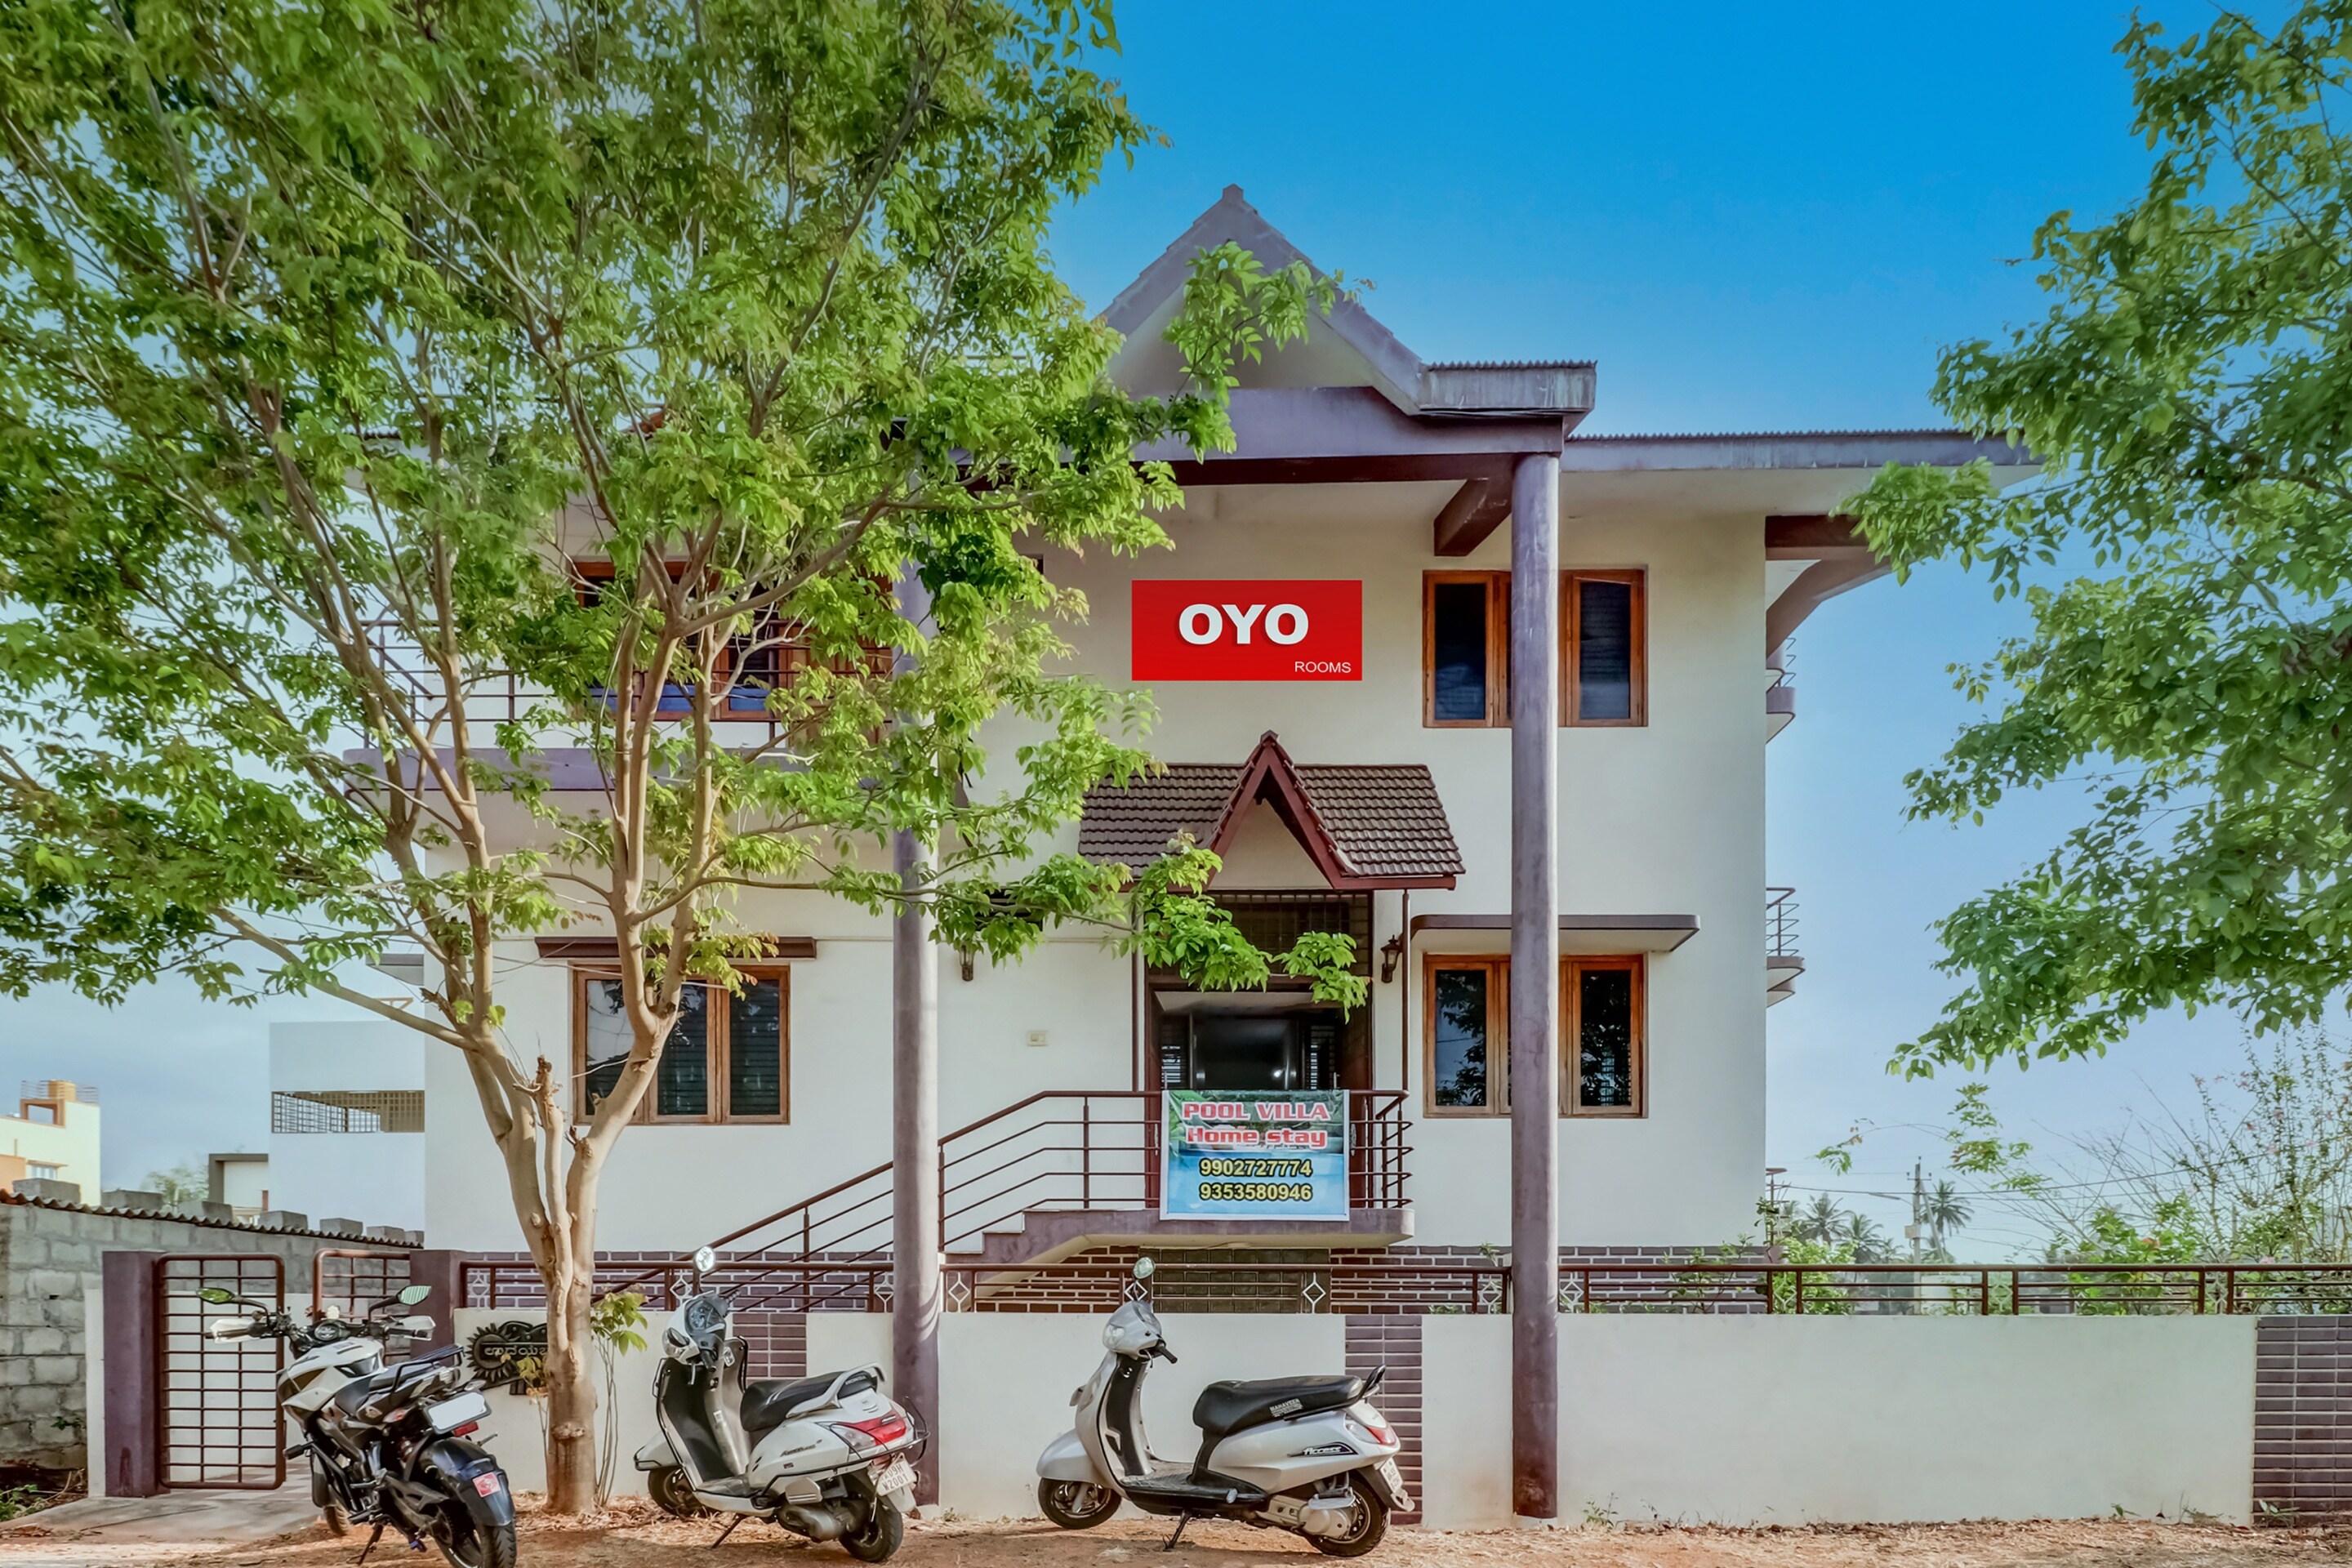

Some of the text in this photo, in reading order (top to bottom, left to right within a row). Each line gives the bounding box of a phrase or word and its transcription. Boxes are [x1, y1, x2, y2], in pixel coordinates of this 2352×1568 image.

[1178, 604, 1308, 645] OYO
[1294, 661, 1352, 674] ROOMS
[1183, 1102, 1330, 1120] POOL VILLA
[1187, 1126, 1327, 1149] Home stay
[1200, 1159, 1312, 1176] 9902727774
[1200, 1183, 1312, 1200] 9353580946
